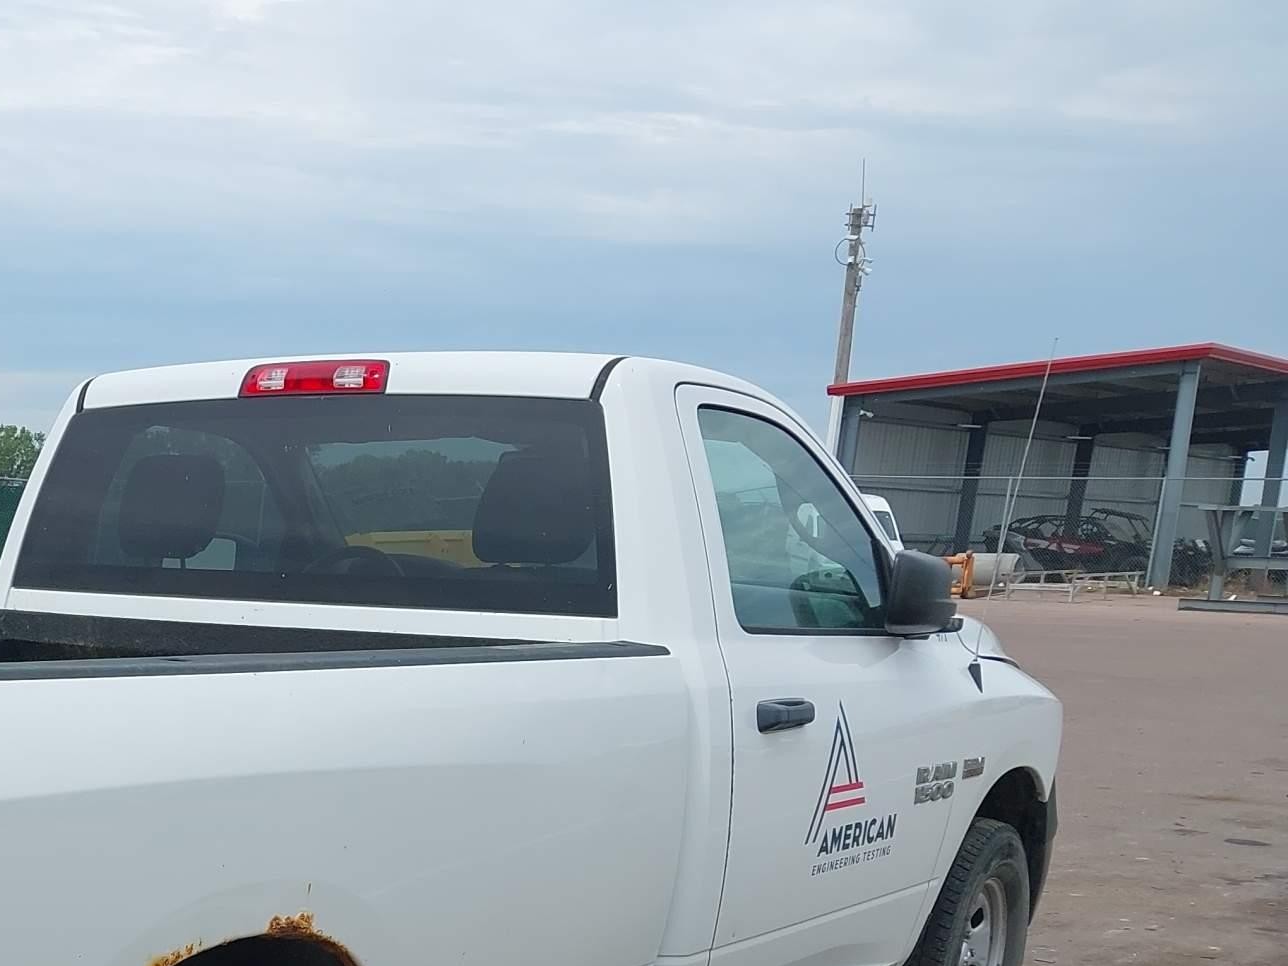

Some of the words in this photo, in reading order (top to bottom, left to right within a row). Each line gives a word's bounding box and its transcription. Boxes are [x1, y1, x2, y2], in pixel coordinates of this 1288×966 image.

[816, 813, 897, 857] AMERICAN
[811, 853, 861, 876] ENGINEERING
[862, 845, 892, 862] TESTING
